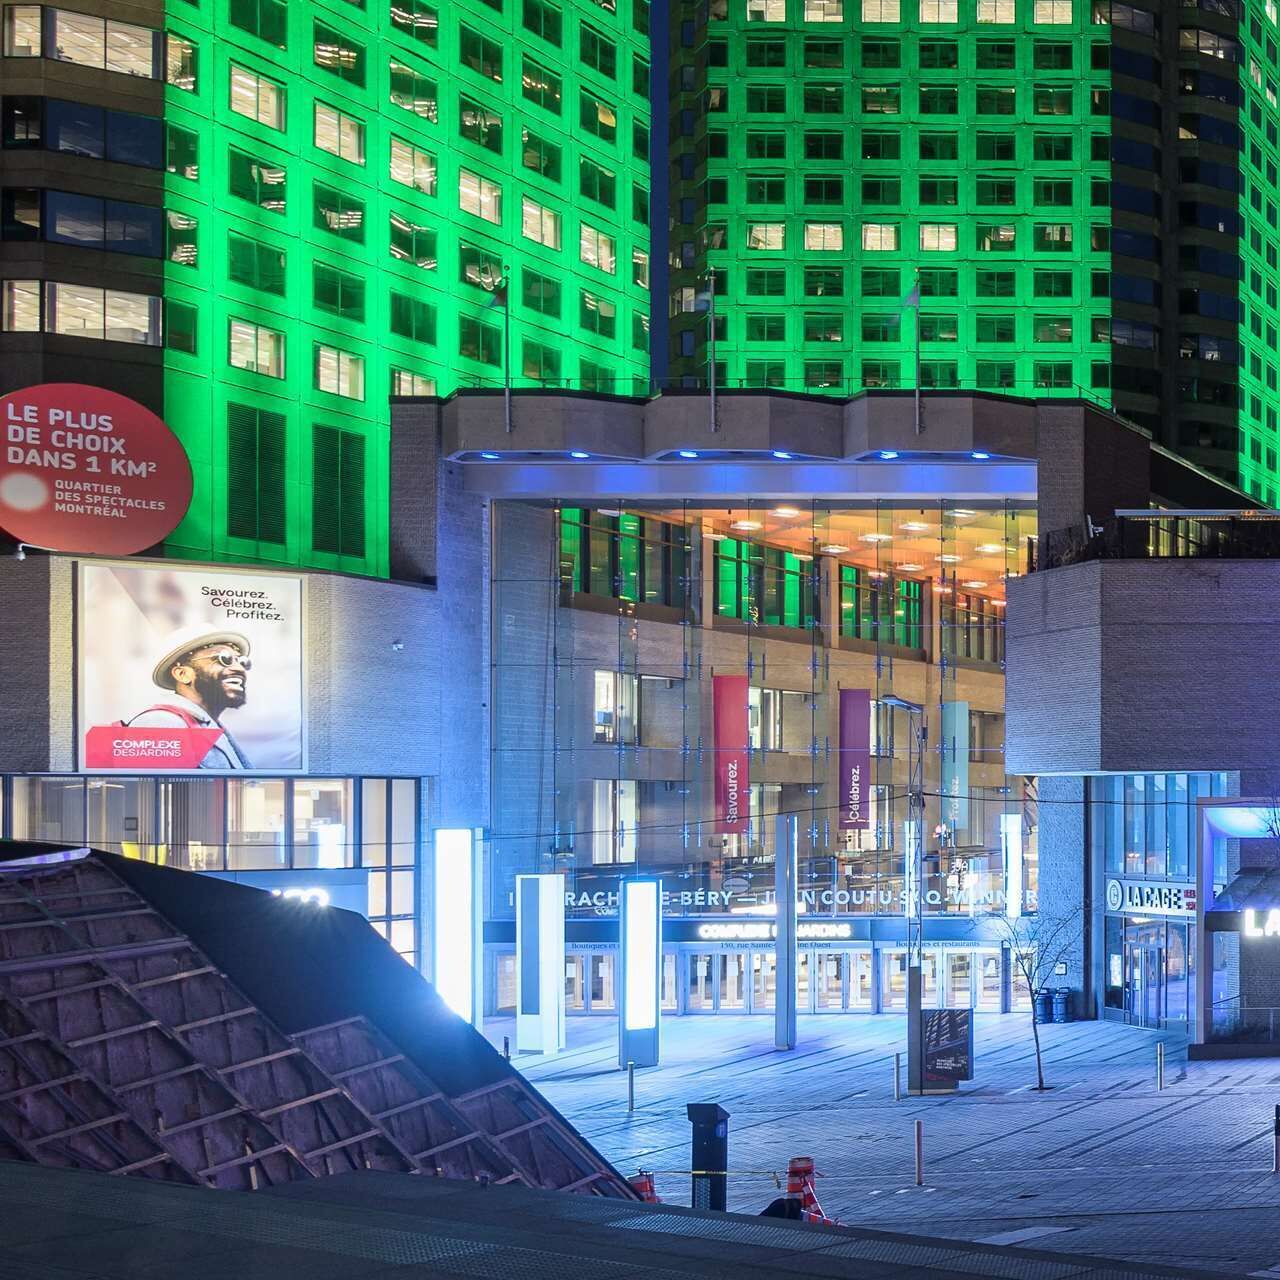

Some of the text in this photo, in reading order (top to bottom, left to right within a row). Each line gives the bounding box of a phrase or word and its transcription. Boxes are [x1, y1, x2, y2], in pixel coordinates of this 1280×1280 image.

[7, 402, 114, 432] LE PLUS
[7, 424, 126, 455] DE CHOIX
[7, 446, 77, 470] DANS
[85, 455, 102, 473] 1
[54, 479, 122, 495] QUARTIER
[54, 491, 166, 511] DES SPECTACLES
[54, 502, 127, 518] MONTRÉAL
[201, 586, 268, 600] Savourez.
[211, 597, 277, 611] Célébrez.
[226, 609, 285, 622] Profitez.
[112, 739, 182, 749] COMPLEXE
[113, 748, 182, 758] DESJARDINS
[726, 759, 738, 824] Savourez.
[848, 765, 860, 820] Célébrez.
[1126, 886, 1143, 906] LA
[1144, 887, 1182, 910] CAGE
